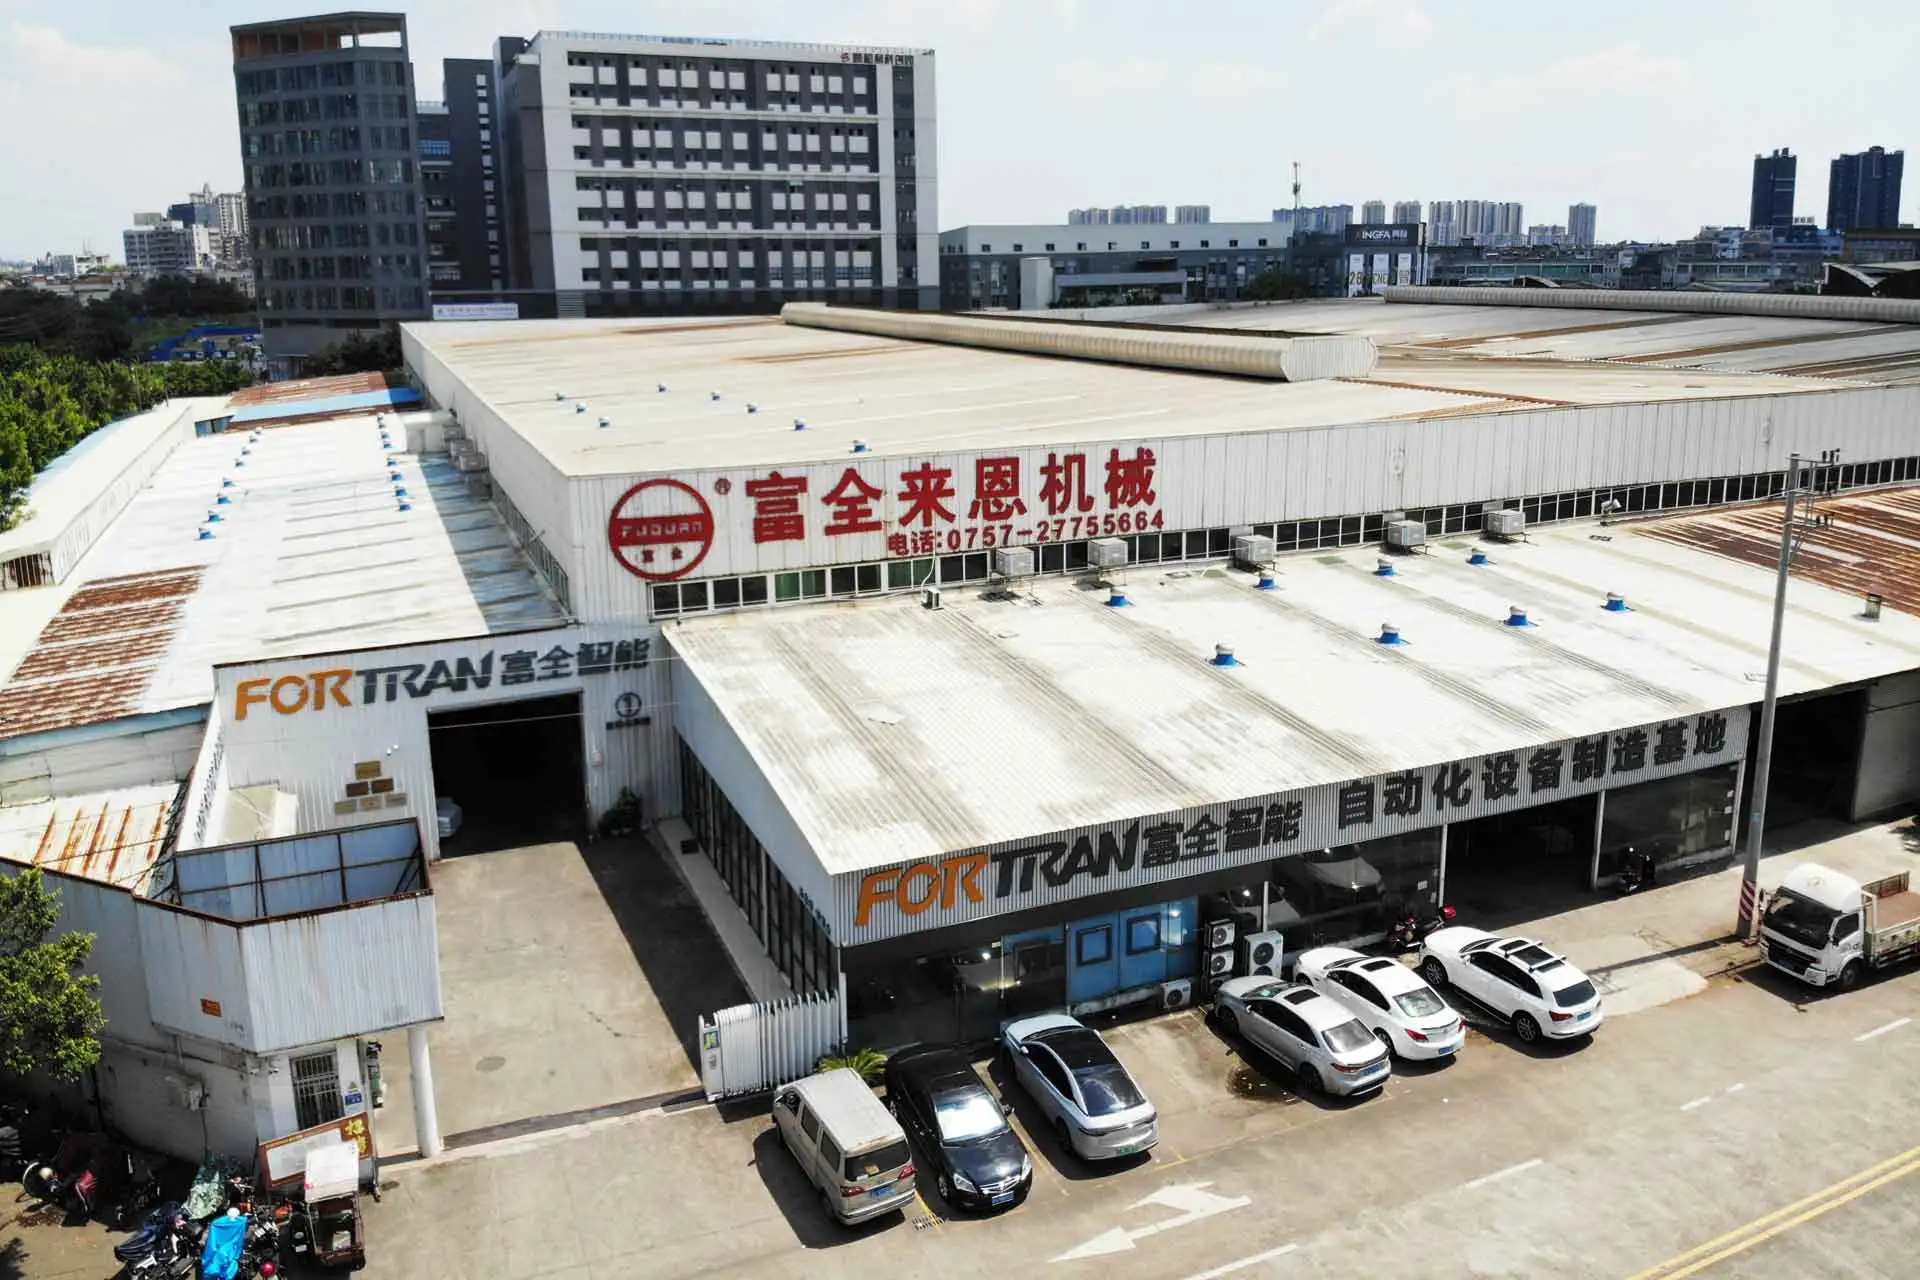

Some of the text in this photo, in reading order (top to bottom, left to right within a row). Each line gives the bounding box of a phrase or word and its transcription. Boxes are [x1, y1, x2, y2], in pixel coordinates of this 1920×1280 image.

[745, 447, 1157, 544] 富全来恩机械
[235, 638, 651, 721] FORTRAN 富全智能
[854, 713, 1728, 927] FORTRAN 富全智能 自动化设备制造基地
